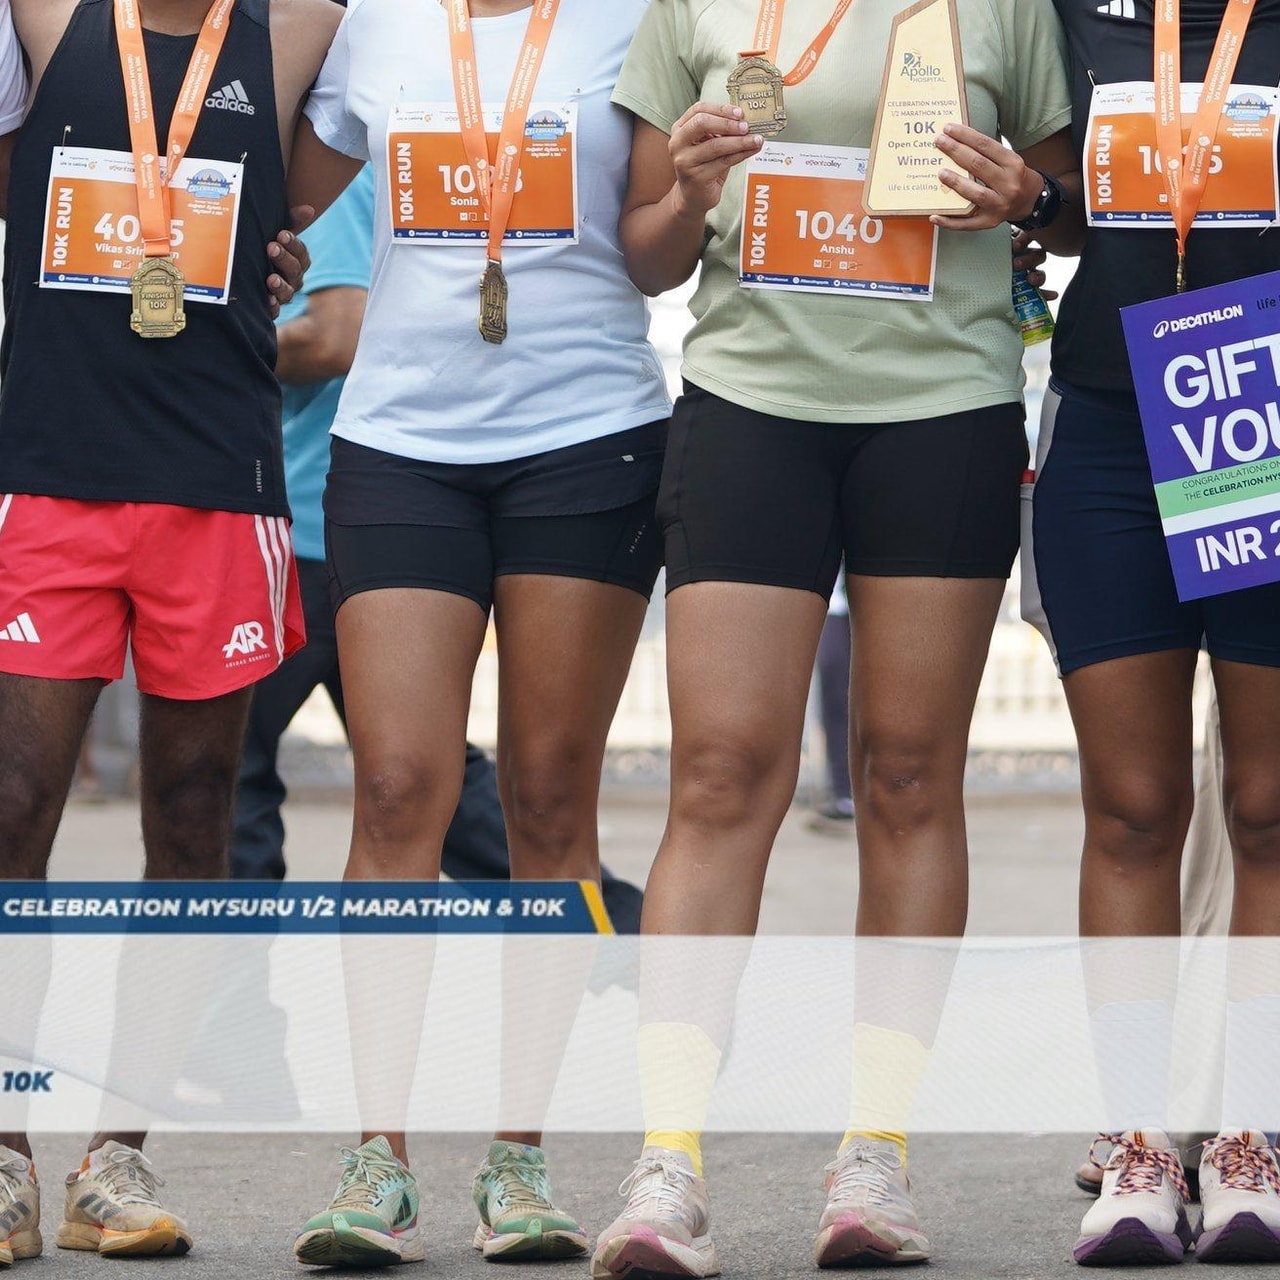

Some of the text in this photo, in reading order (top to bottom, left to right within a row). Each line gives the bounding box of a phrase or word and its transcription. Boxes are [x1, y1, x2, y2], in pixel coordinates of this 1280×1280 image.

[900, 65, 941, 83] Apollo
[1206, 29, 1232, 104] CELEBRATION MYSURU
[738, 91, 774, 101] FINISHER
[747, 100, 767, 110] 10K
[204, 96, 255, 116] adidas
[904, 121, 936, 135] 10K
[887, 140, 910, 151] Open
[897, 155, 943, 166] Winner
[1095, 124, 1113, 205] 10K RUN
[397, 142, 414, 223] 10K RUN
[888, 183, 938, 193] life is calling
[450, 197, 479, 206] Sonia
[52, 187, 74, 267] 10K RUN
[94, 212, 185, 247] 405
[750, 184, 769, 267] 10K RUN
[795, 209, 884, 245] 1040
[95, 242, 122, 254] Vikas
[820, 244, 855, 255] Anshu
[141, 292, 175, 301] FINISHER
[149, 301, 167, 309] 10K
[1256, 297, 1276, 312] life
[1170, 304, 1244, 334] DECATHLON
[1182, 464, 1268, 489] CONGRATULATIONS
[1185, 491, 1202, 501] THE
[1203, 477, 1264, 497] CELEBRATION
[1196, 525, 1264, 574] INR
